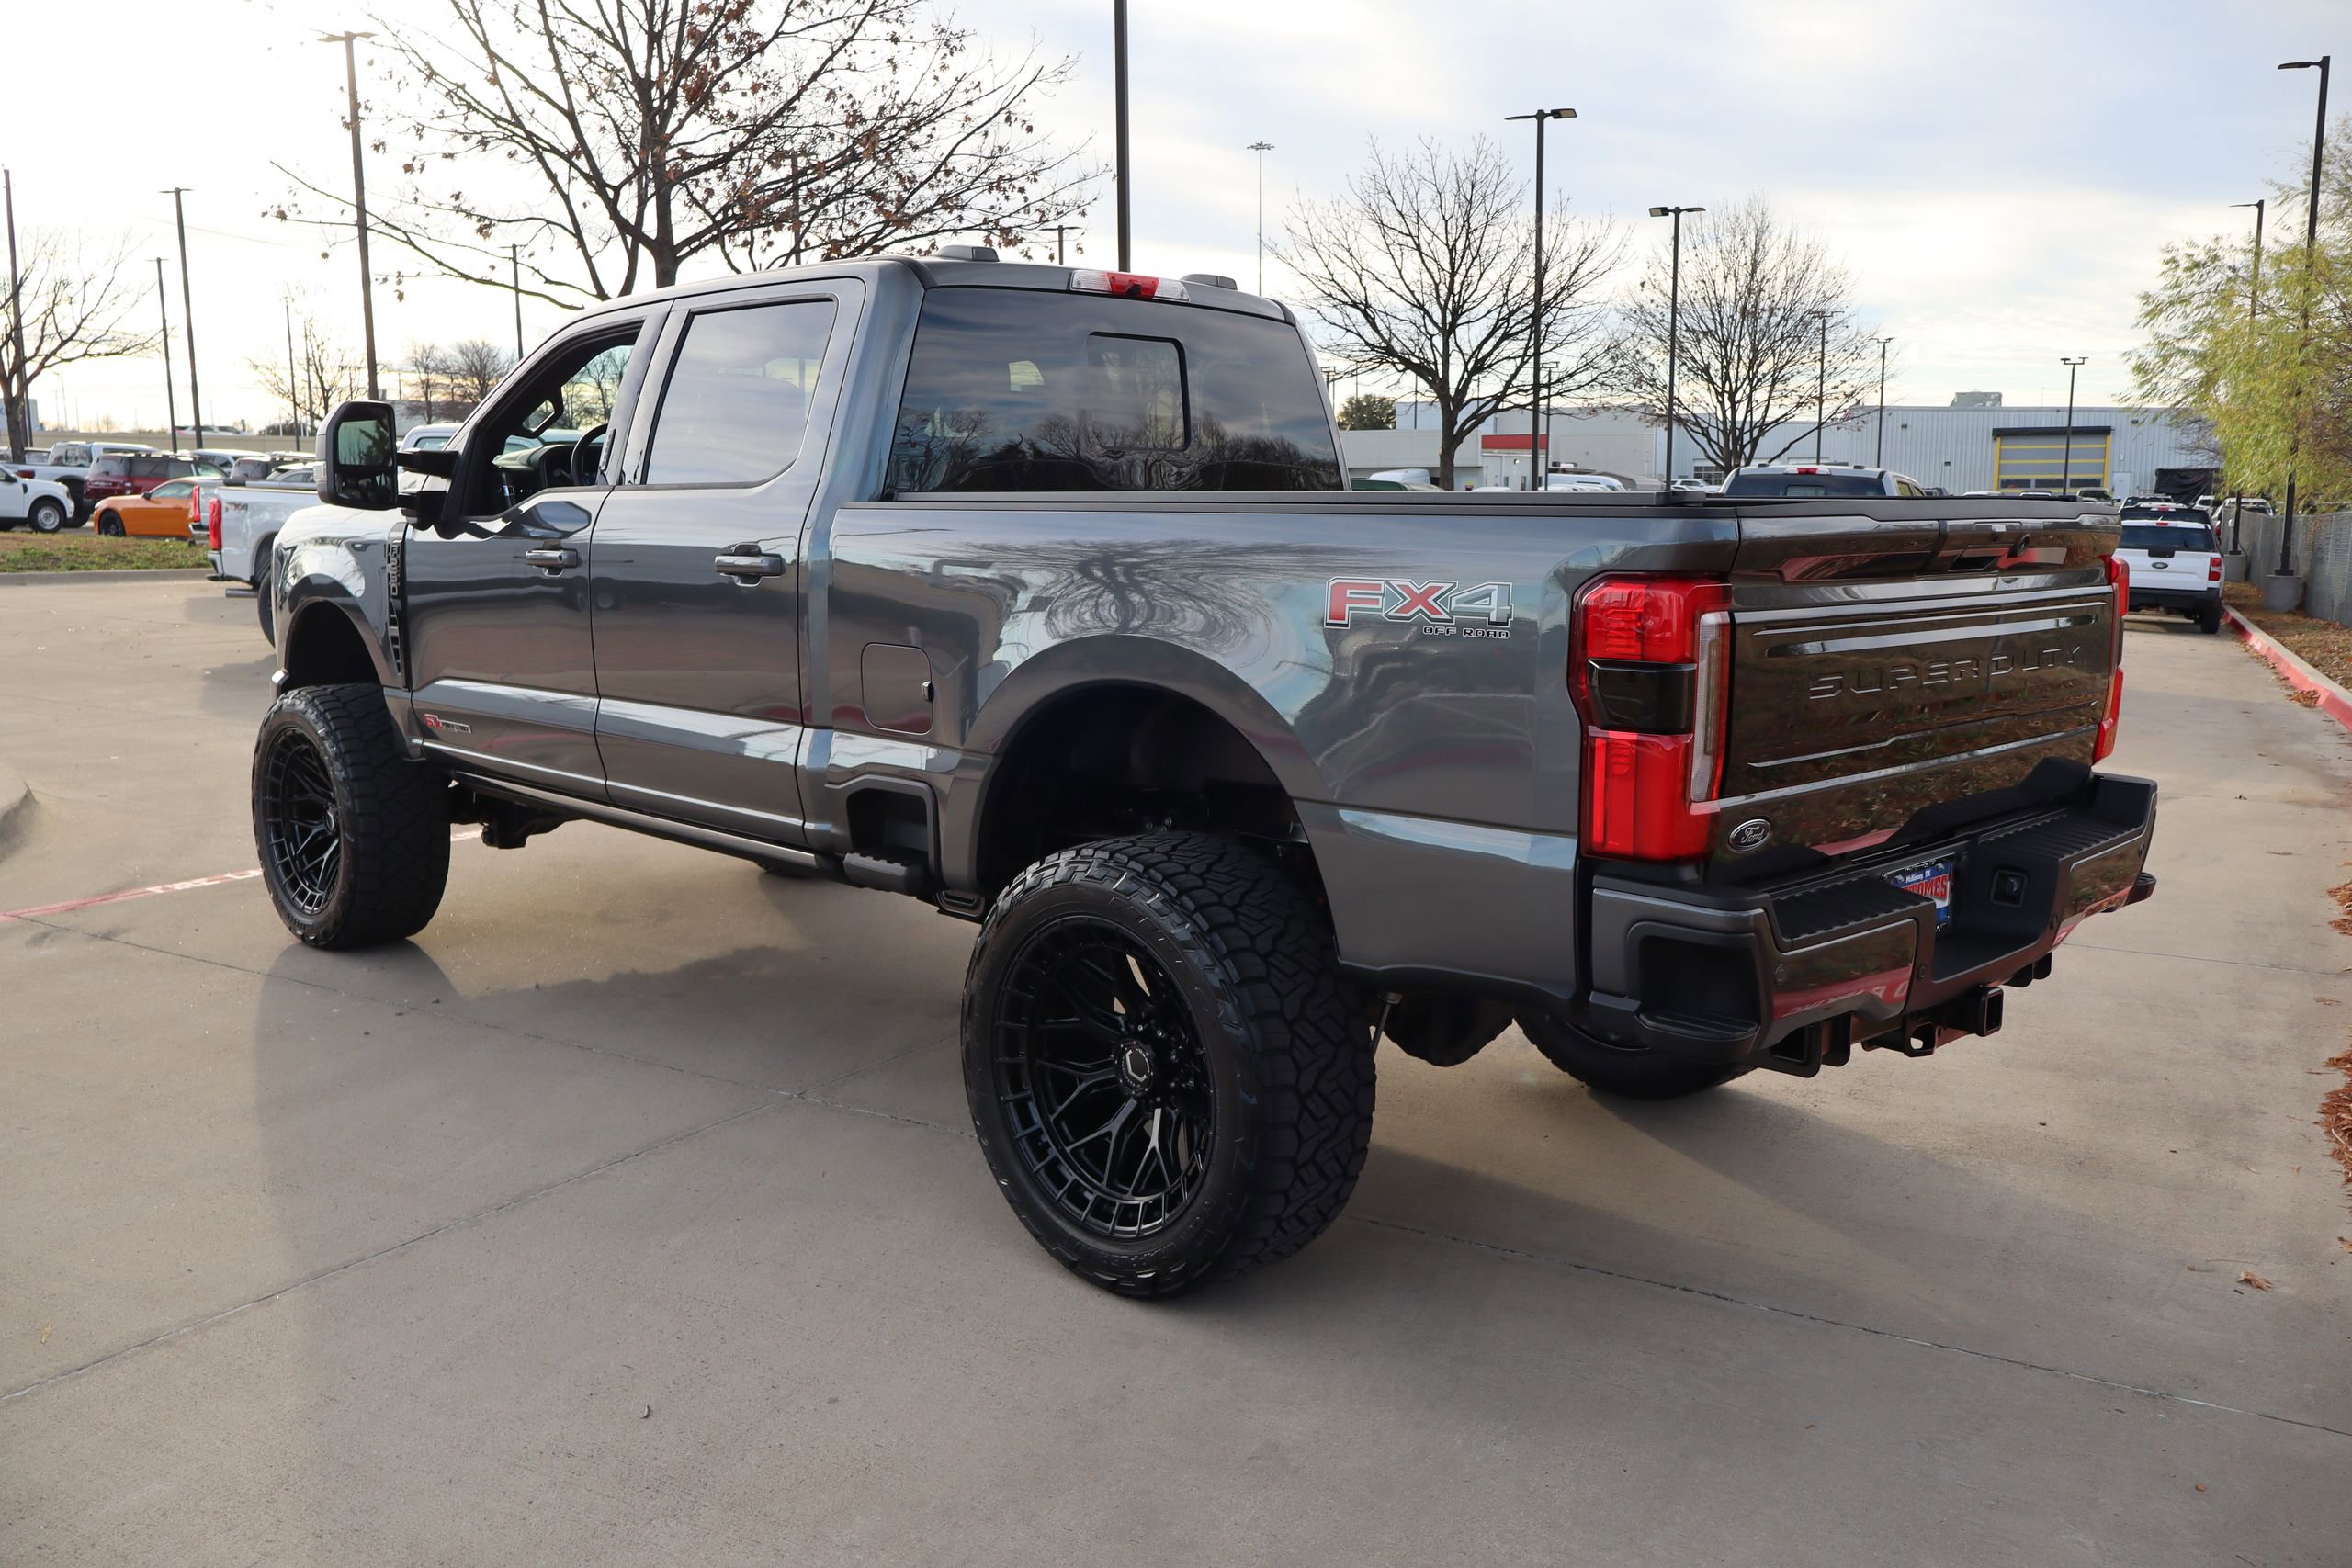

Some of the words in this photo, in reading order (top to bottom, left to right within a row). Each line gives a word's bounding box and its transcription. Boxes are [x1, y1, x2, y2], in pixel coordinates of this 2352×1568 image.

[1324, 576, 1514, 629] FX4
[1423, 626, 1456, 636] OFF
[1463, 627, 1510, 639] ROAD
[1808, 655, 1980, 700] SUPER
[1990, 646, 2081, 676] DUTY
